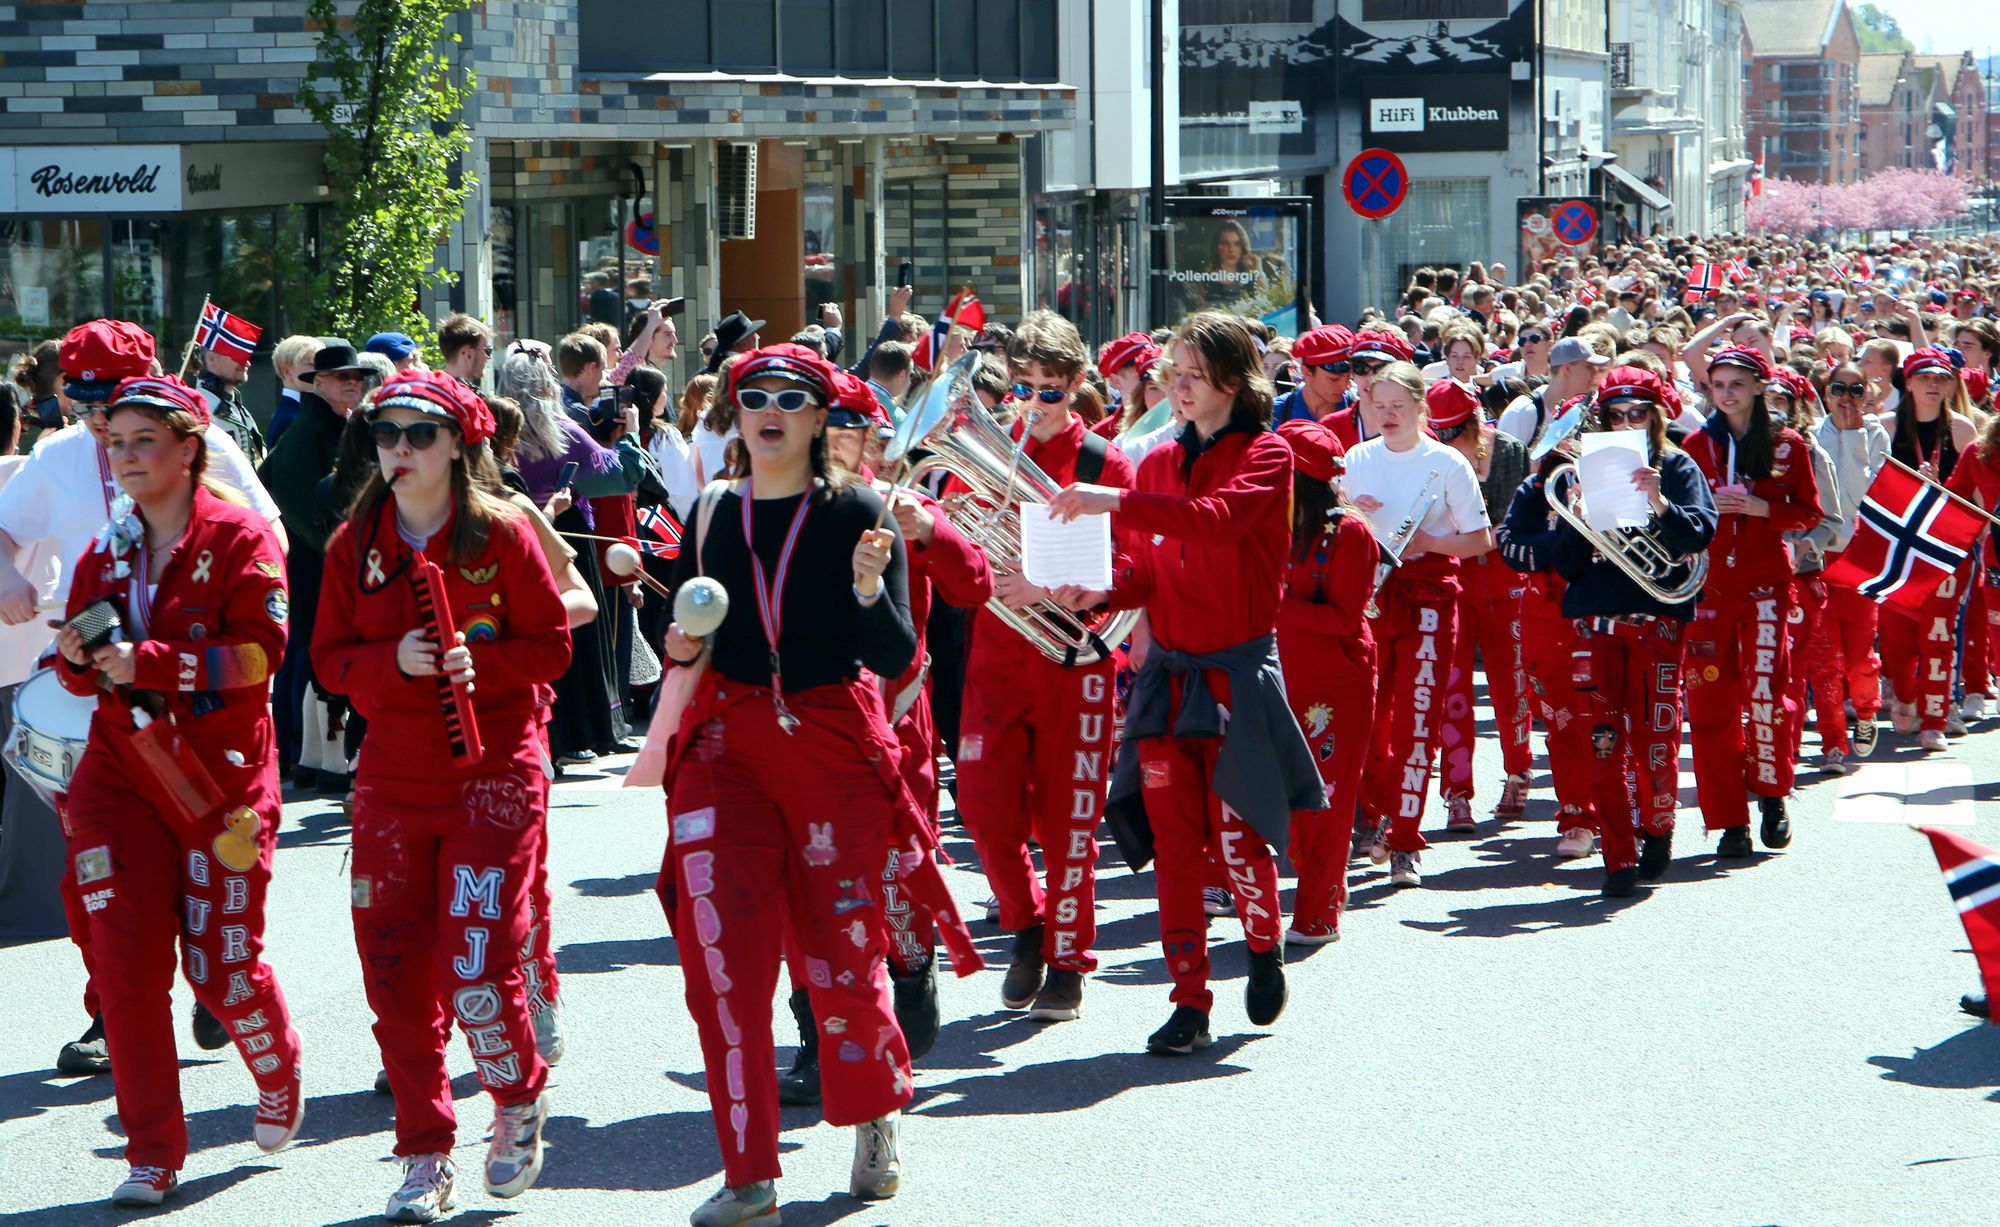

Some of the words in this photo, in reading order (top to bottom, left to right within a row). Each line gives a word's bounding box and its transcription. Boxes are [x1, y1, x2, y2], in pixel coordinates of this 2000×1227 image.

[31, 163, 161, 197] Rosenvold
[1379, 108, 1415, 122] HiFi
[1428, 106, 1499, 121] Klubben
[1168, 269, 1260, 284] Pollenallergi?
[1400, 607, 1440, 818] BAASLAND
[1752, 599, 1779, 785] KREANDER
[223, 876, 281, 1074] BRANDS
[450, 864, 523, 1089] MJØEN
